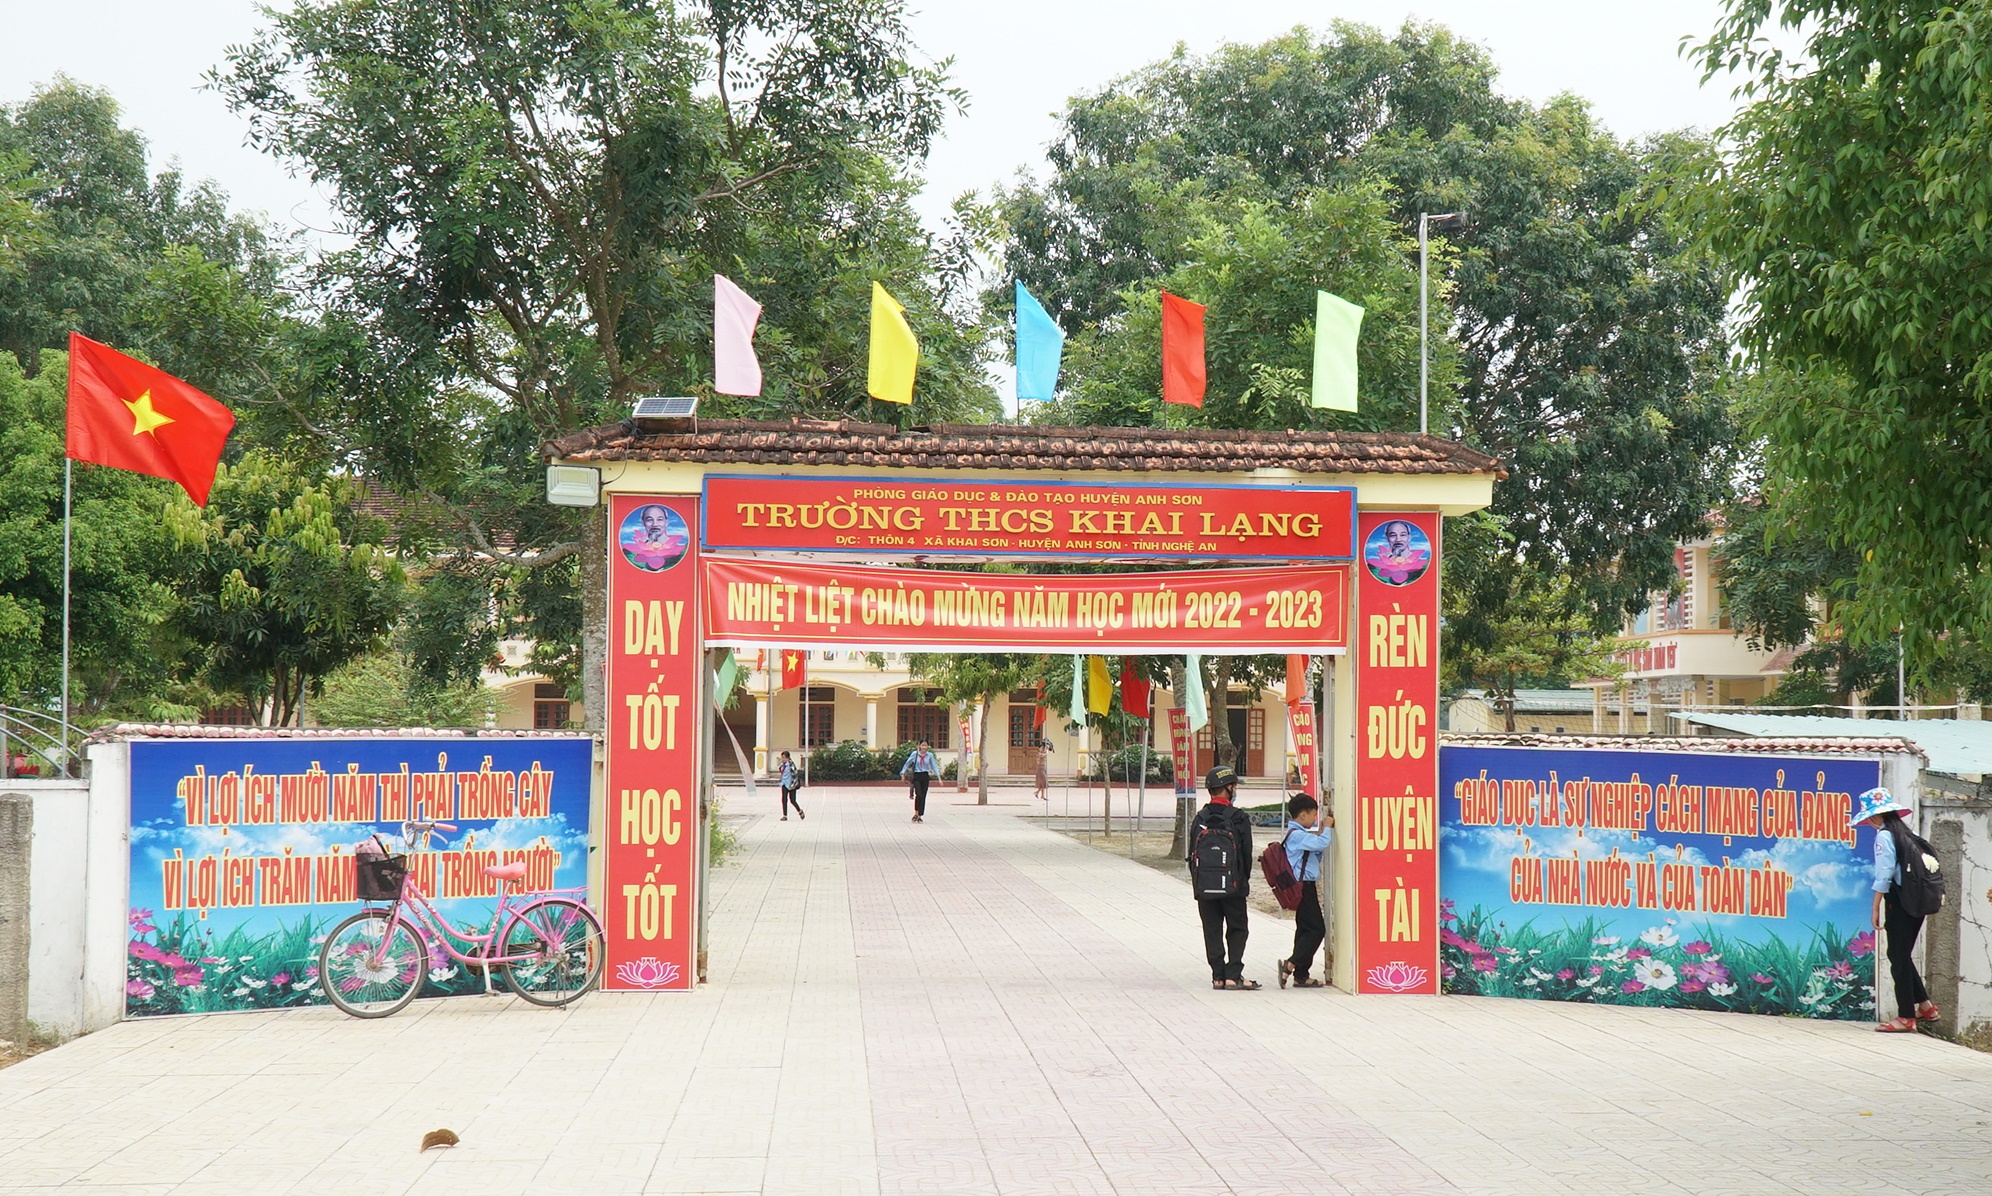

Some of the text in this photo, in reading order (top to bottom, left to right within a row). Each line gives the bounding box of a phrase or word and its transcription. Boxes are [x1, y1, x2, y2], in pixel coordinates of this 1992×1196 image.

[737, 495, 1323, 542] TRƯỜNG THCS KHAI LẠNG
[853, 486, 1203, 507] PHÒNG GIÁO DỤC & ĐÀO TẠO HUYỆN ANH SƠN
[868, 534, 904, 546] THÔN
[907, 536, 916, 546] 4
[924, 535, 943, 547] XÃ
[947, 537, 978, 547] KHAI
[982, 537, 1009, 548] SƠN
[1018, 537, 1061, 551] HUYỆN
[1066, 539, 1092, 549] ANH
[1095, 539, 1121, 550] SƠN
[1162, 541, 1194, 553] NGHỆ
[1198, 543, 1217, 551] AN
[625, 600, 684, 668] DẠY
[727, 576, 798, 632] NHIỆT
[805, 579, 854, 633] LIỆT
[861, 581, 925, 626] CHÀO
[933, 582, 1006, 628] MỪNG
[1013, 585, 1069, 628] NĂM
[1076, 591, 1124, 637] HỌC
[1132, 582, 1177, 628] MỚI
[1184, 591, 1242, 628] 2022
[1265, 590, 1323, 628] 2023
[1369, 603, 1427, 667] RÈN
[625, 674, 680, 750] TỐT
[1367, 689, 1426, 759] ĐỨC
[207, 770, 239, 837] LỢI
[242, 764, 277, 825] ÍCH
[279, 760, 330, 824] MƯỜI
[332, 762, 377, 823] NĂM
[379, 762, 410, 822] THÌ
[411, 751, 455, 821] PHẢI
[457, 754, 516, 820] TRỒNG
[517, 760, 554, 819] CÂY
[620, 788, 681, 858] HỌC
[1362, 785, 1433, 862] LUYỆN
[1501, 779, 1536, 837] DỤC
[1538, 770, 1561, 828] LÀ
[1563, 776, 1590, 838] SỰ
[1590, 772, 1653, 842] NGHIỆP
[1655, 774, 1702, 834] CÁCH
[1705, 785, 1759, 847] MẠNG
[1761, 768, 1799, 839] CỦA
[1801, 771, 1857, 849] ĐẢNG,
[163, 847, 184, 910] VÌ
[185, 855, 218, 920] LỢI
[220, 846, 255, 907] ÍCH
[257, 846, 312, 907] TRĂM
[314, 844, 358, 904] NĂM
[405, 830, 438, 899] HẢI
[441, 835, 498, 899] TRỒNG
[622, 863, 677, 940] TỐT
[1375, 876, 1420, 942] TÀI
[1510, 837, 1544, 905] CỦA
[1547, 849, 1583, 906] NHÀ
[1585, 846, 1632, 908] NƯỚC
[1635, 852, 1659, 910] VÀ
[1661, 842, 1697, 912] CỦA
[1700, 855, 1746, 917] TOÀN
